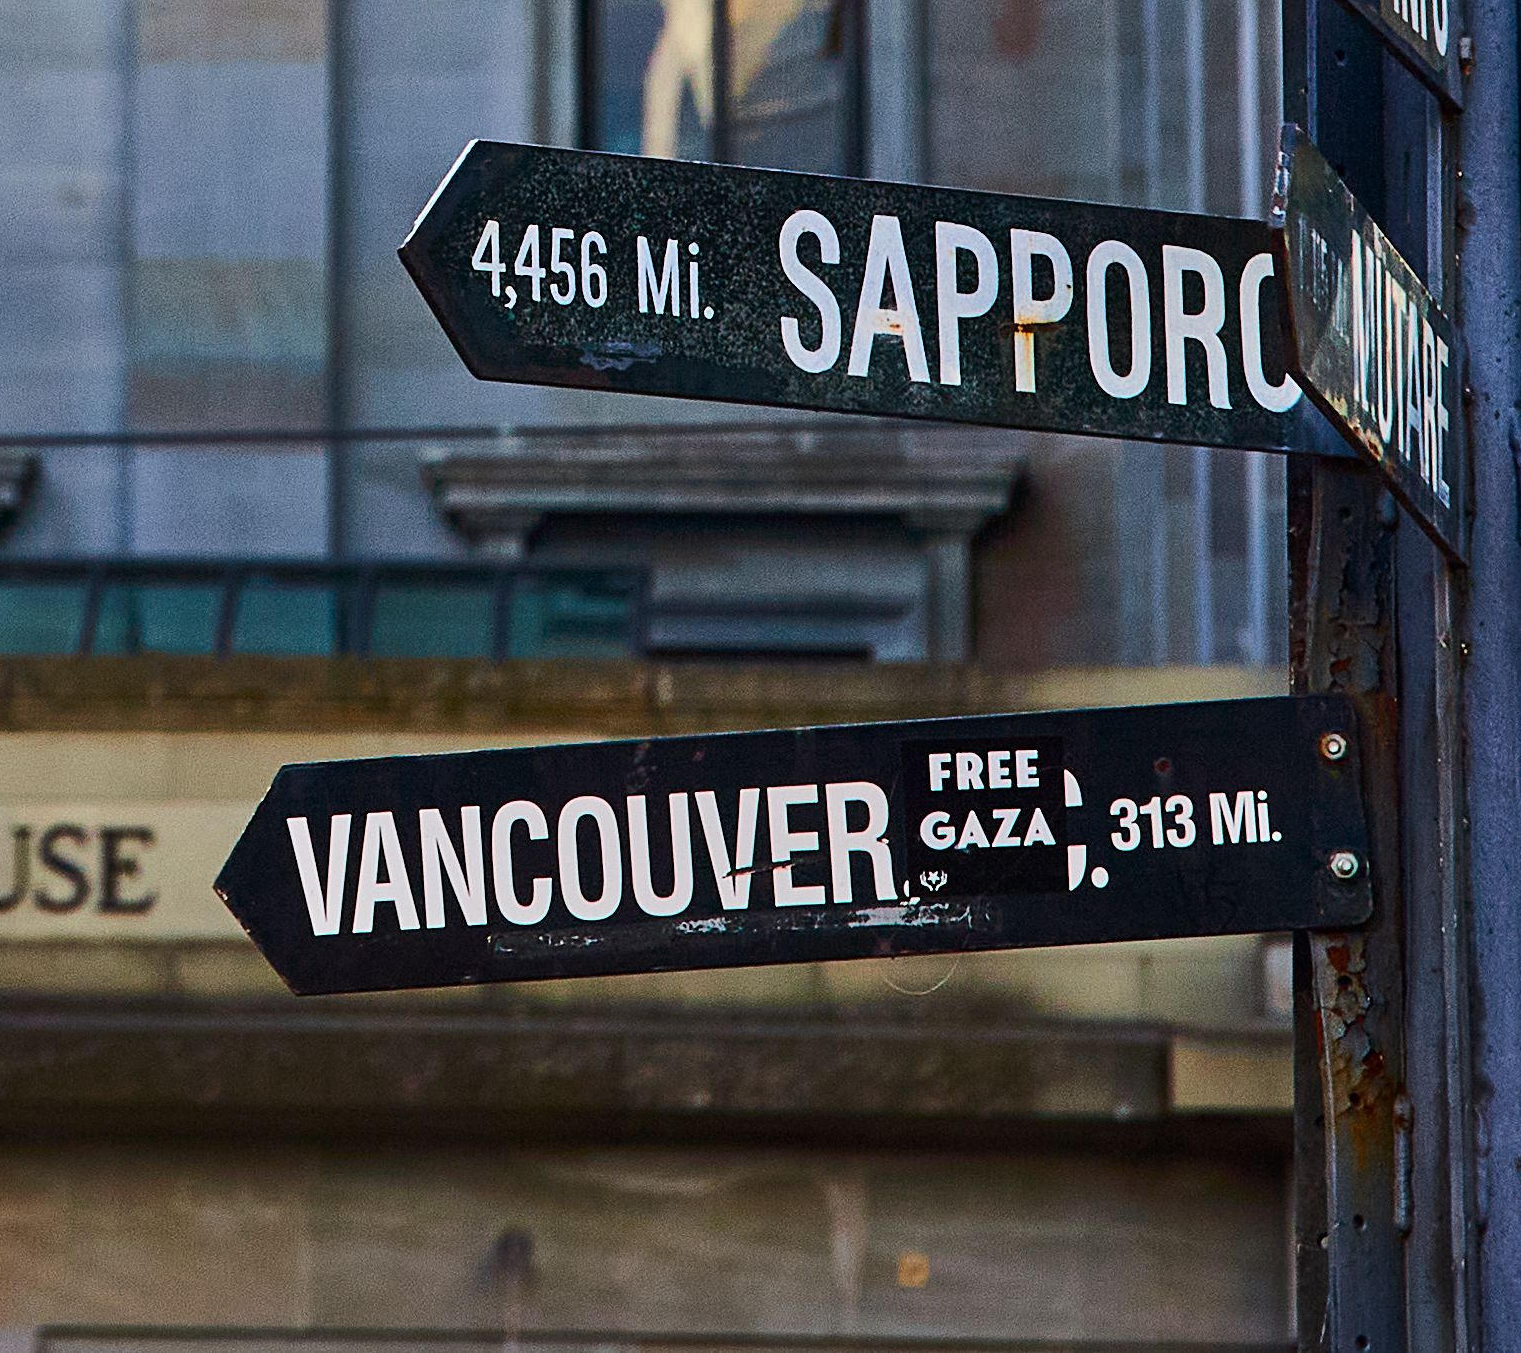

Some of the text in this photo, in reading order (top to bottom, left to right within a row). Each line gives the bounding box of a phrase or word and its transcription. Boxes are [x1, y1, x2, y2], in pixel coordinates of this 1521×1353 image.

[472, 219, 608, 310] 4,456
[637, 235, 715, 320] Mi.
[1351, 228, 1450, 510] MUTARE
[928, 749, 1040, 792] FREE
[285, 781, 899, 938] VANCOUVER
[1109, 795, 1198, 852] 313
[1208, 789, 1283, 845] Mi.
[919, 807, 1057, 851] GAZA
